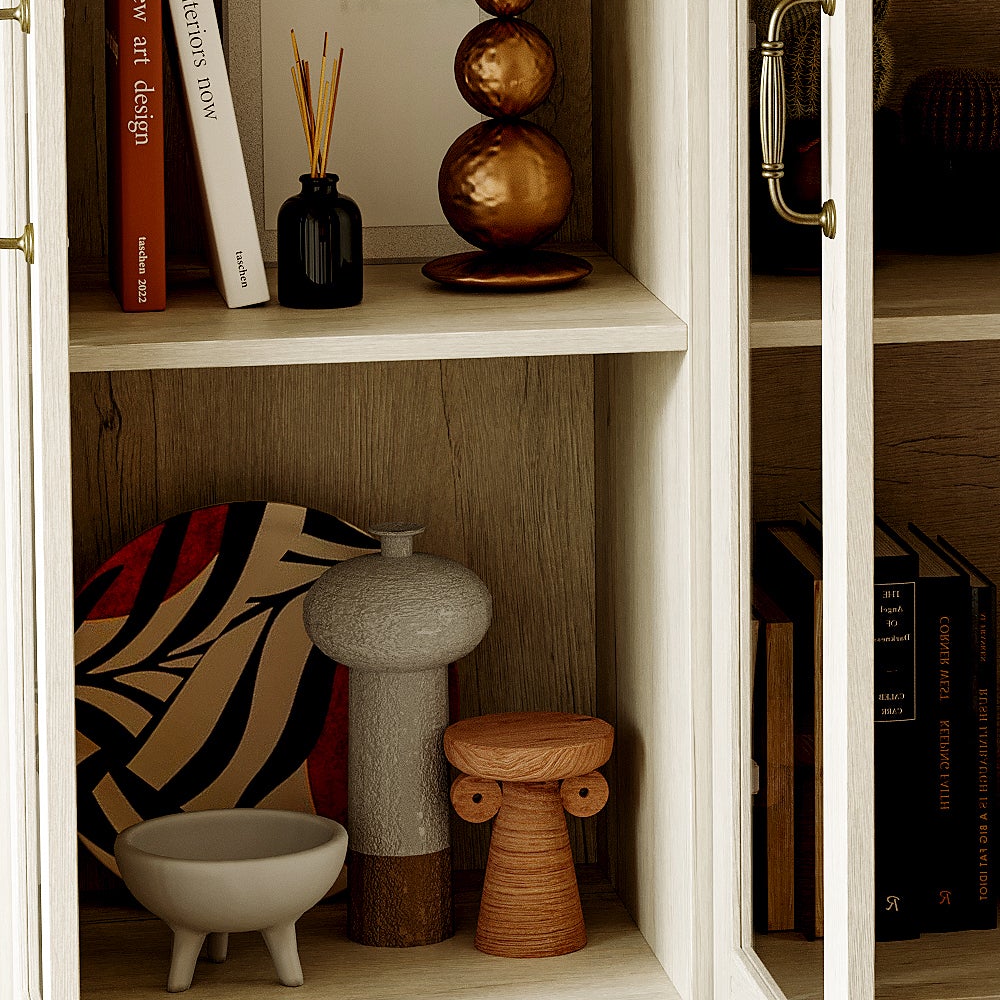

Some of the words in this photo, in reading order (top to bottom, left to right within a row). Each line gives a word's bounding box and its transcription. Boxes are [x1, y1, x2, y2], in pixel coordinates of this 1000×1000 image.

[133, 36, 150, 65] art
[127, 80, 155, 146] design
[198, 76, 218, 121] now
[137, 236, 146, 274] taschen
[235, 250, 248, 289] taschen
[137, 279, 147, 303] 2022
